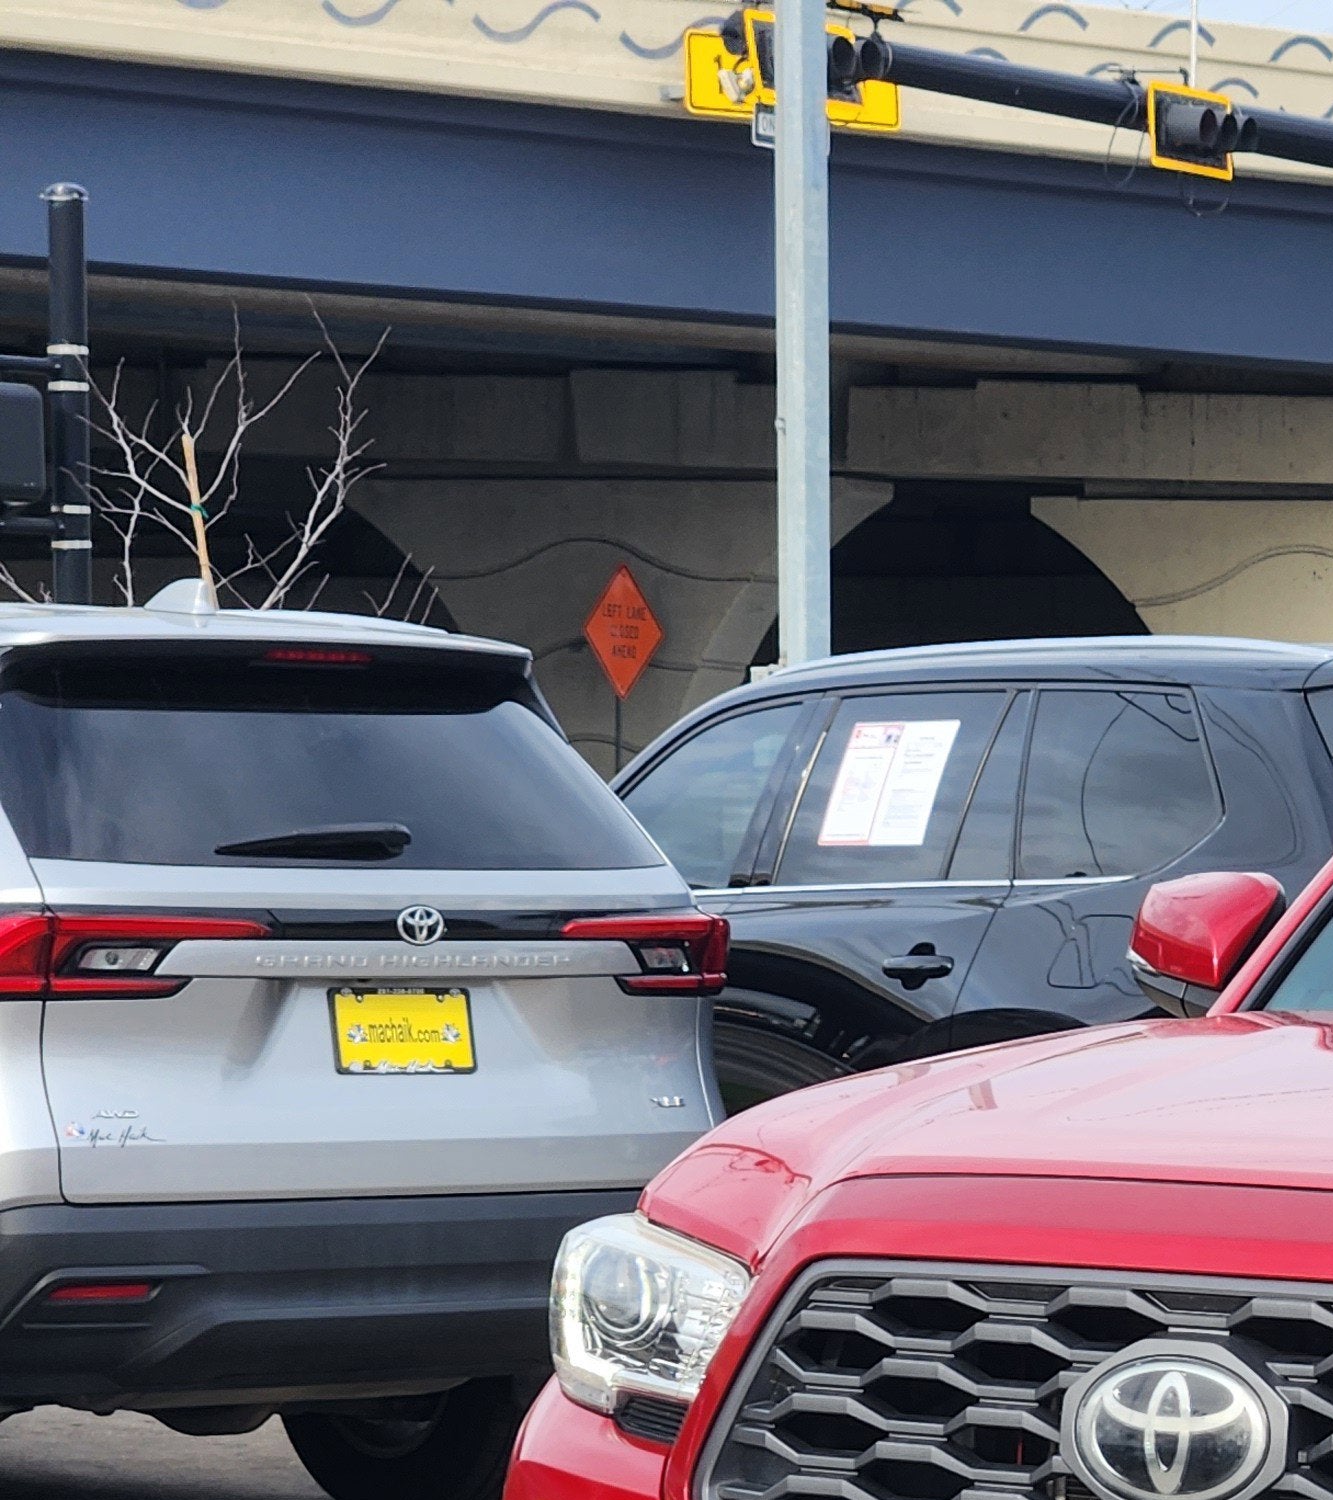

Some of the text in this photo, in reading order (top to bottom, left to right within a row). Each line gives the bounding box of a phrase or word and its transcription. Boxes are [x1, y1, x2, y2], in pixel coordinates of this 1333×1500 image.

[256, 954, 571, 968] GRAND HIGHLANDER
[368, 1017, 441, 1043] machaik.com
